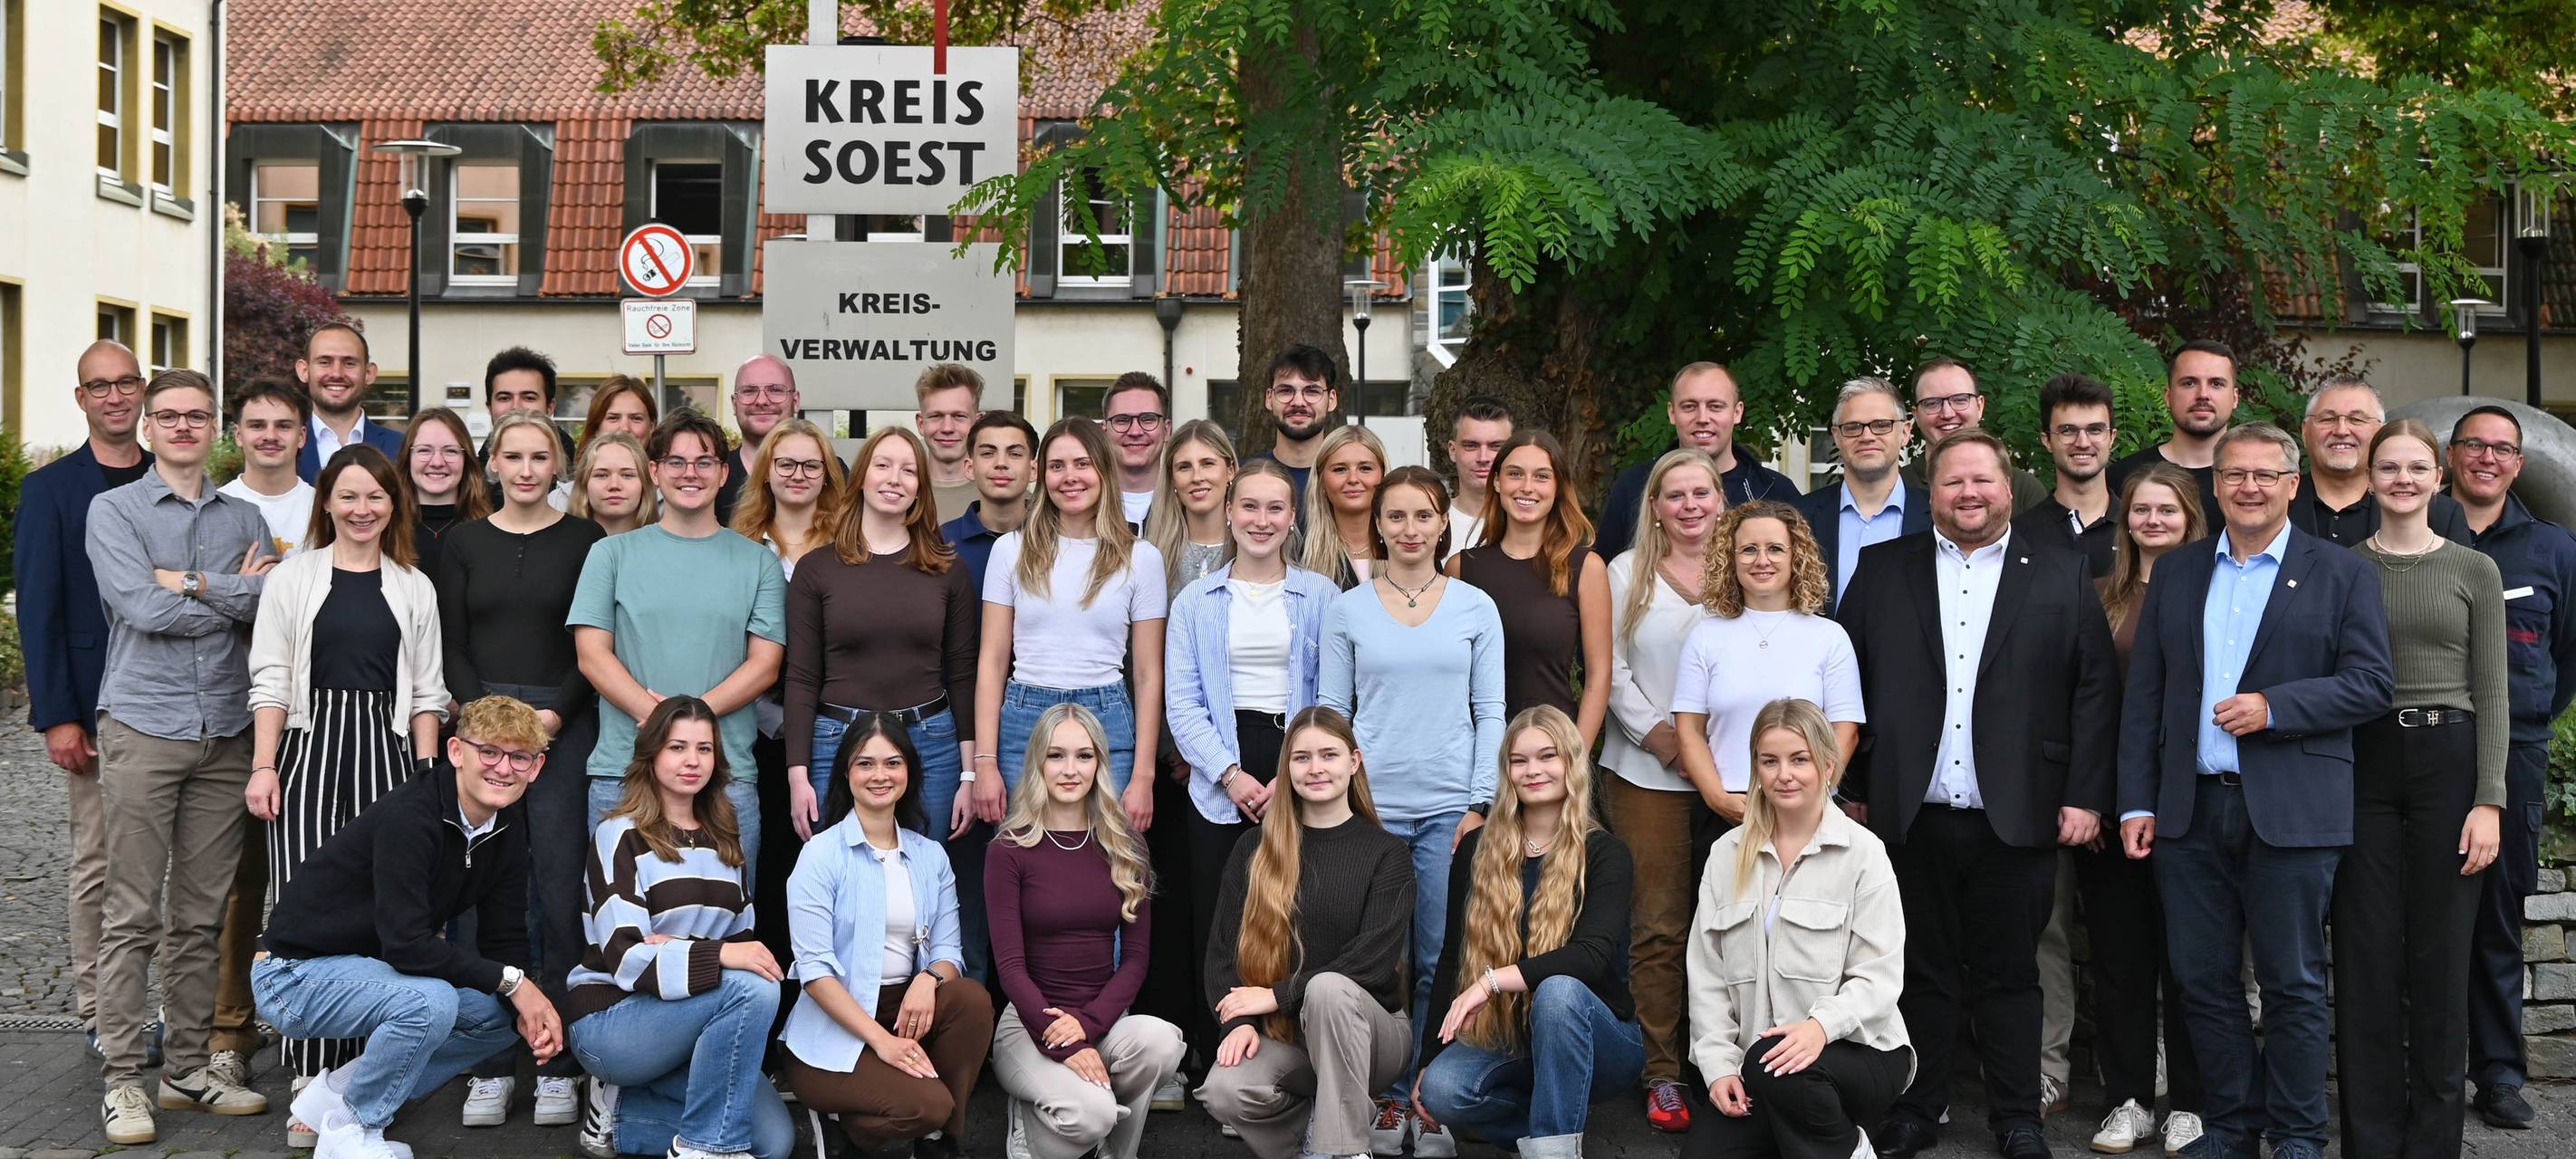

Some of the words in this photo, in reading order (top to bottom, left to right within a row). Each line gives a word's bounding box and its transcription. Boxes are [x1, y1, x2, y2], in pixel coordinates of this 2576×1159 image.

[805, 79, 985, 126] KREIS
[803, 139, 985, 186] SOEST
[839, 292, 941, 314] KREIS-
[779, 339, 996, 361] VERWALTUNG
